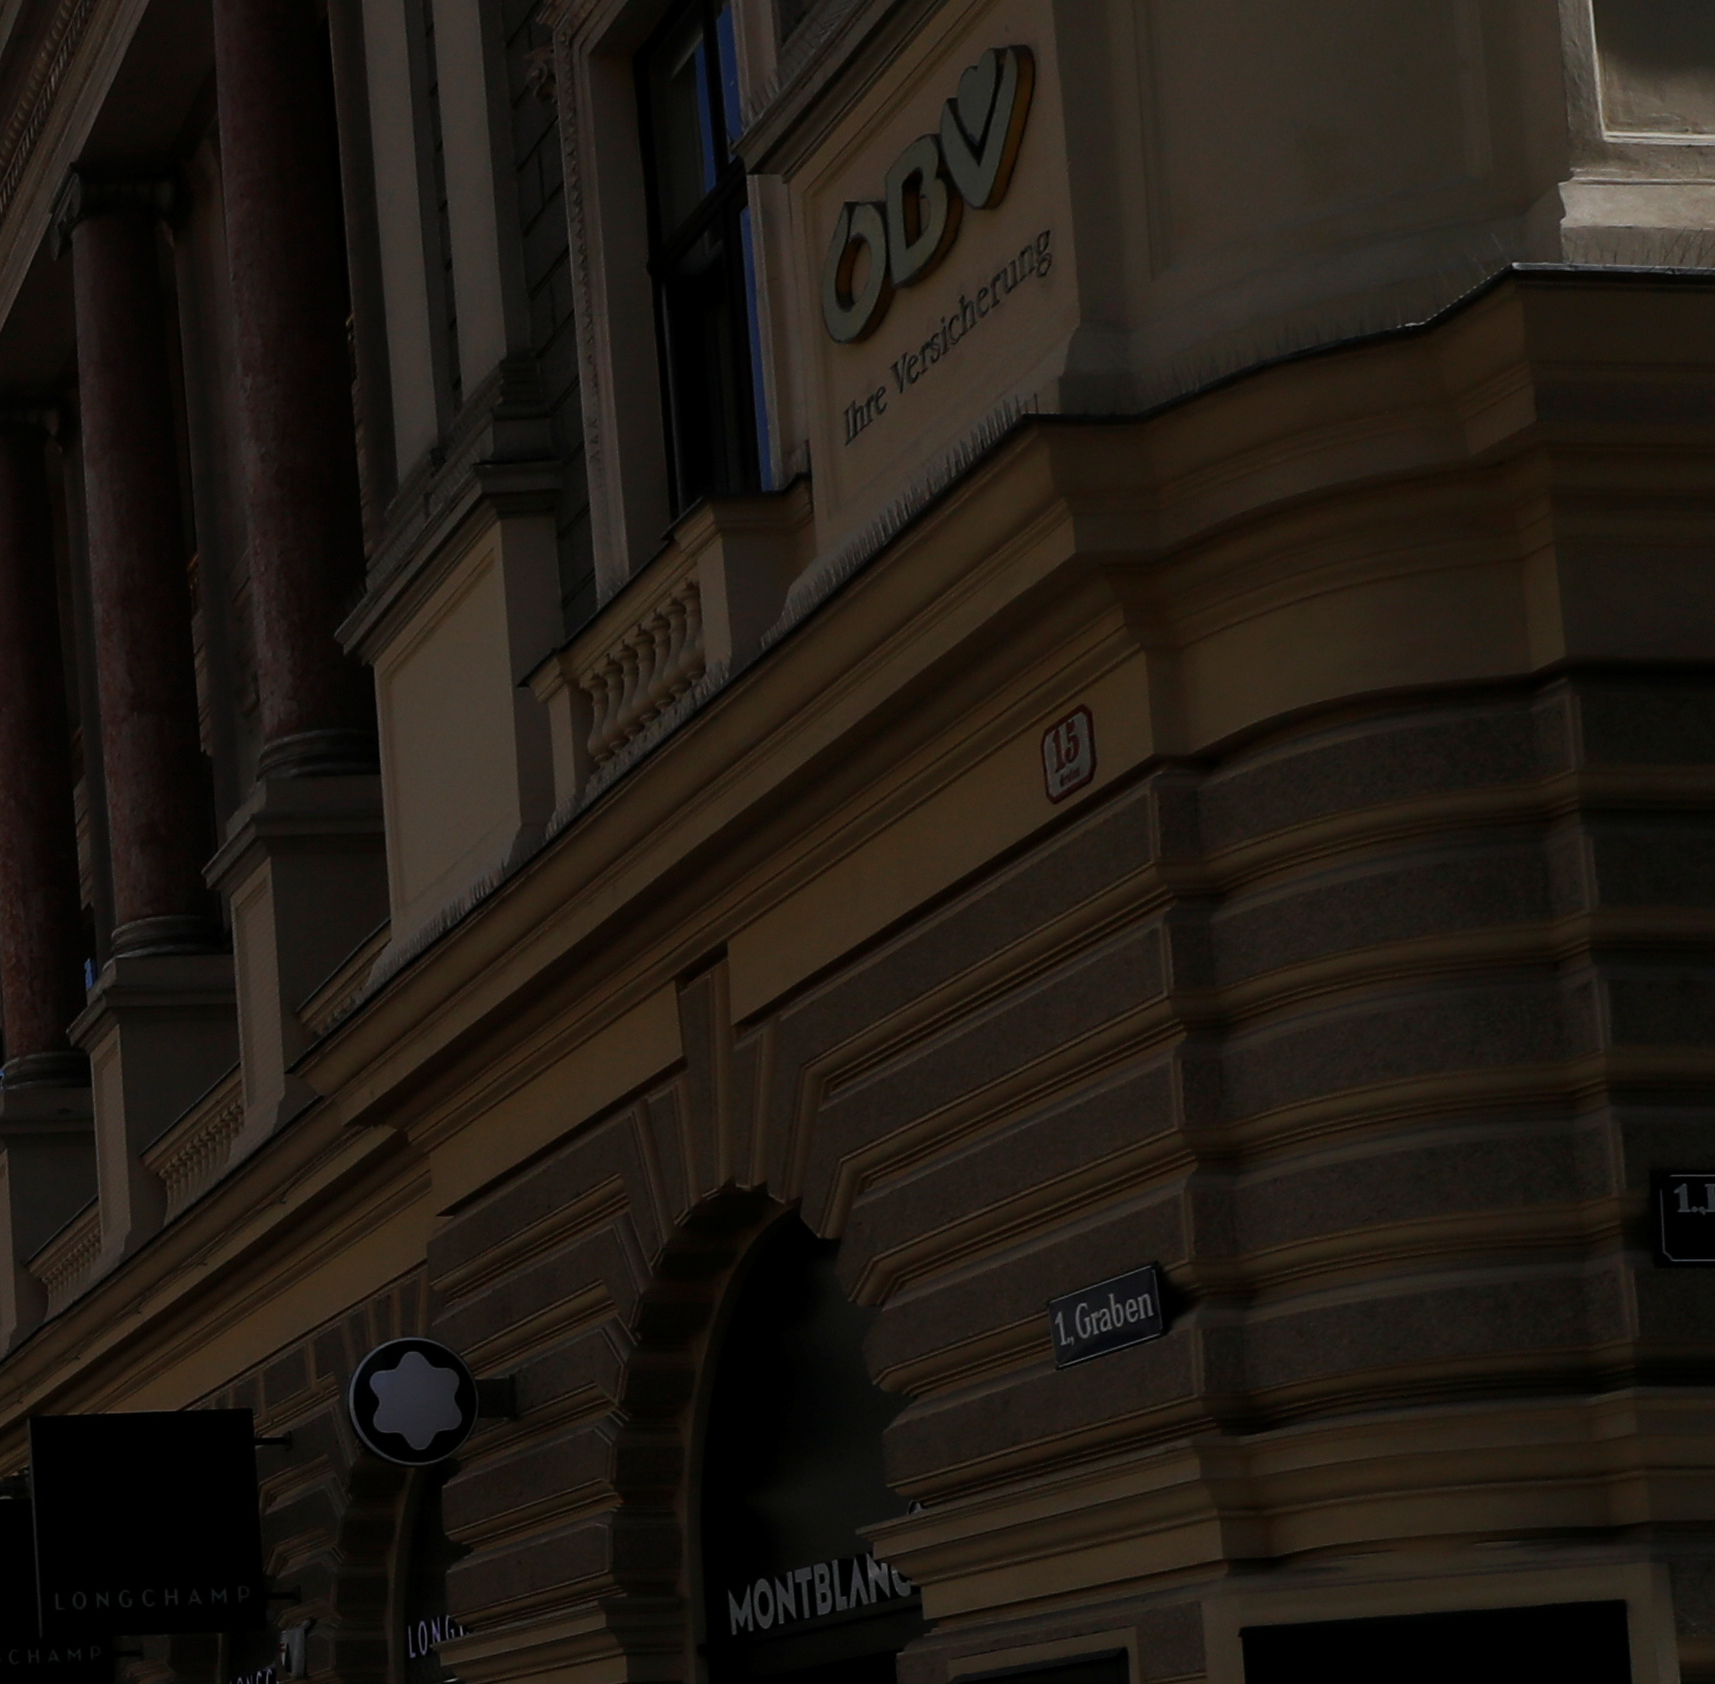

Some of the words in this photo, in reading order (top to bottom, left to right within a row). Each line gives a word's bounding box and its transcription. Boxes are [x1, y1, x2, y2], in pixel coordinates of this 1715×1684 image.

[843, 385, 888, 446] Ihre
[890, 230, 1052, 394] Versicherung
[1053, 719, 1080, 773] 15
[1075, 1293, 1154, 1339] Graben
[53, 1584, 252, 1612] LONGCHAMP
